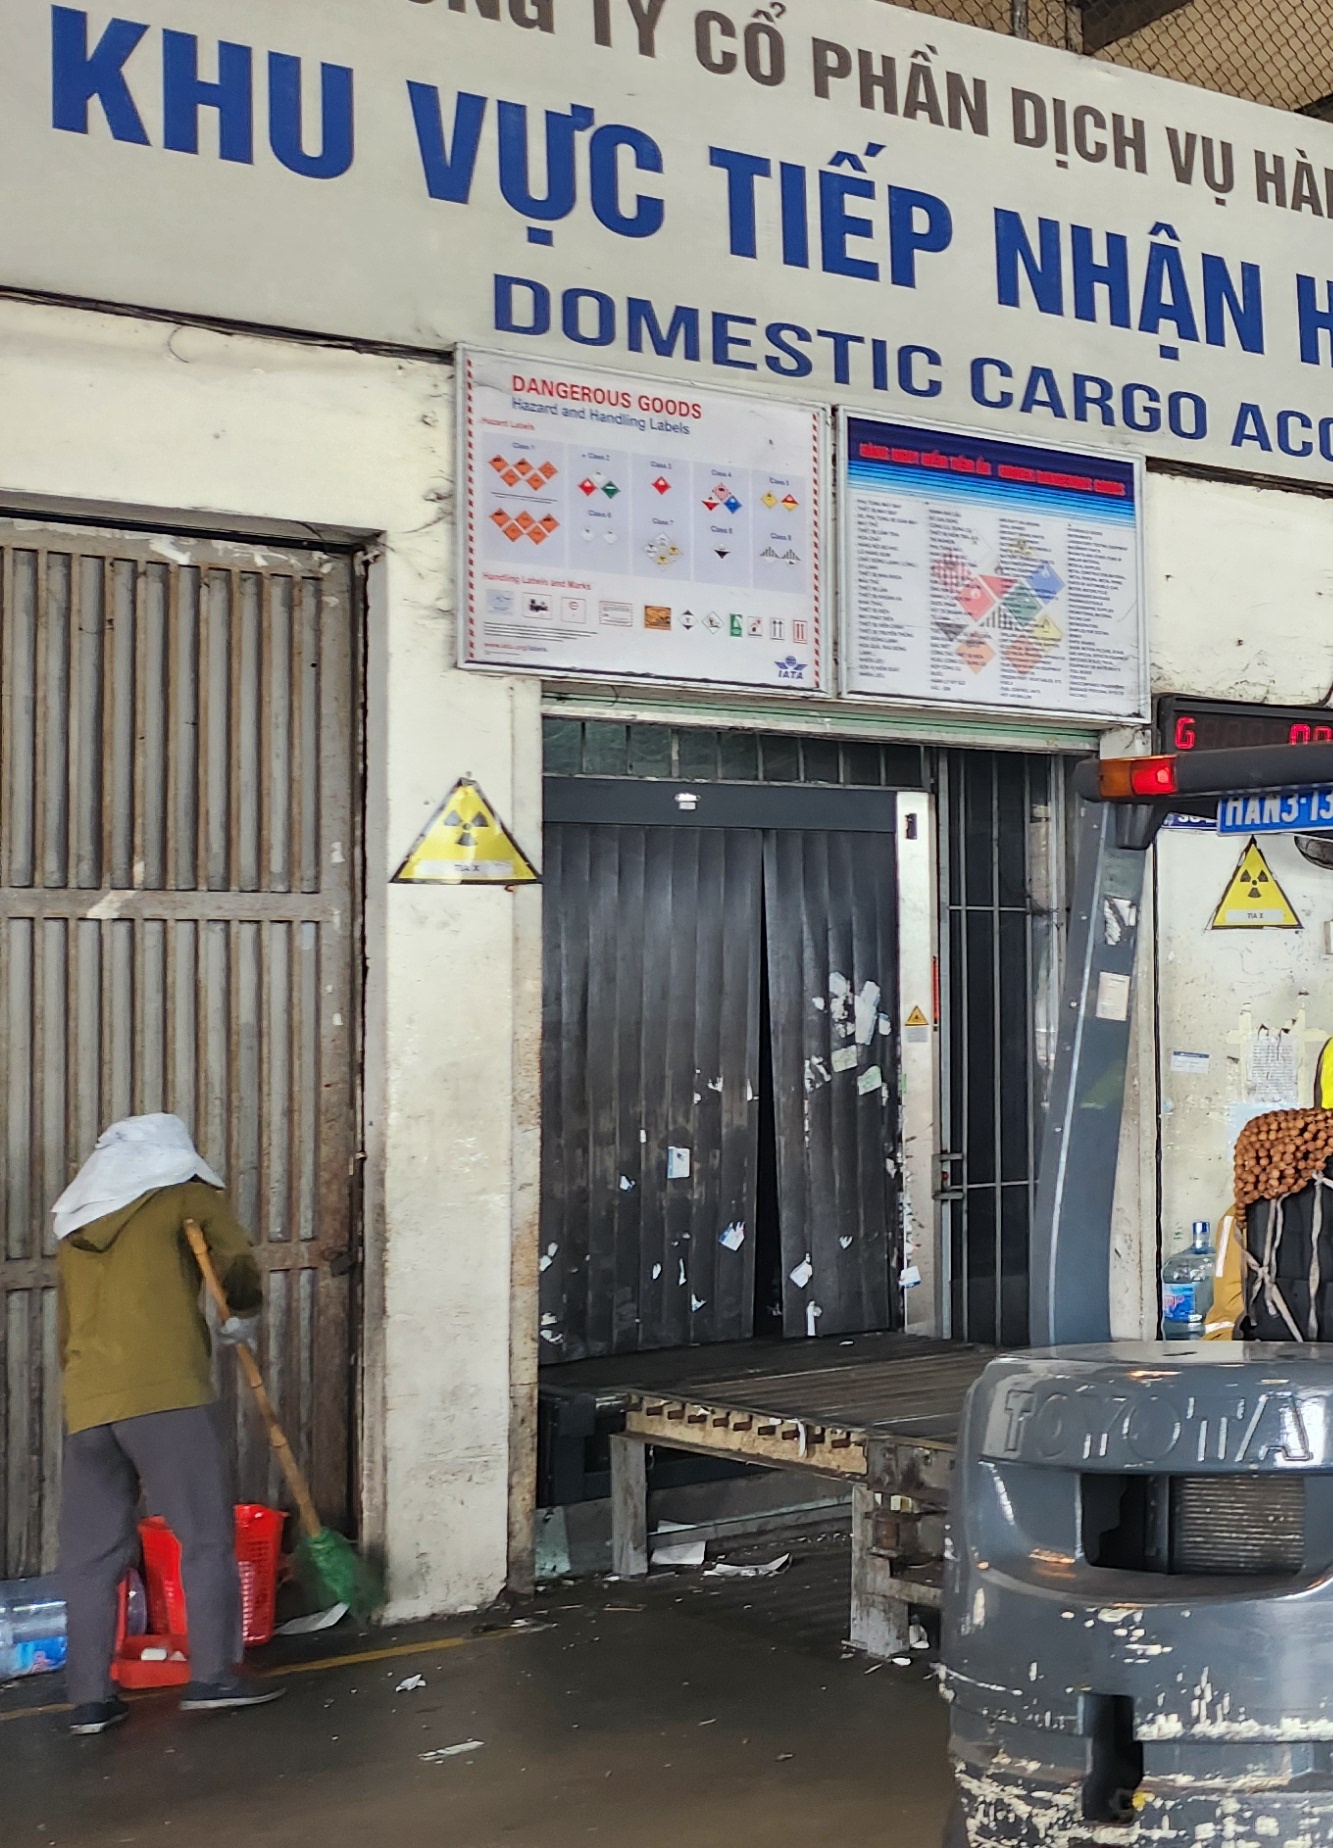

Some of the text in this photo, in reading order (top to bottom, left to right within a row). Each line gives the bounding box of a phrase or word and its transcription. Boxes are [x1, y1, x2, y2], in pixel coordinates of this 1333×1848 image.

[694, 1, 787, 87] CỔ
[811, 44, 989, 137] PHẦN
[1011, 86, 1148, 175] DỊCH
[1165, 126, 1234, 207] VỤ
[50, 4, 353, 179] KHU
[406, 80, 664, 246] VỰC
[709, 143, 952, 287] TIẾP
[994, 222, 1264, 360] NHẬN
[494, 274, 941, 398] DOMESTIC
[971, 357, 1207, 440] CARGO
[511, 375, 702, 419] DANGEROUS GOODS
[511, 396, 691, 435] Hazard and Handling Labels
[777, 669, 805, 680] IATA
[1004, 1389, 1314, 1463] TOYOTA
